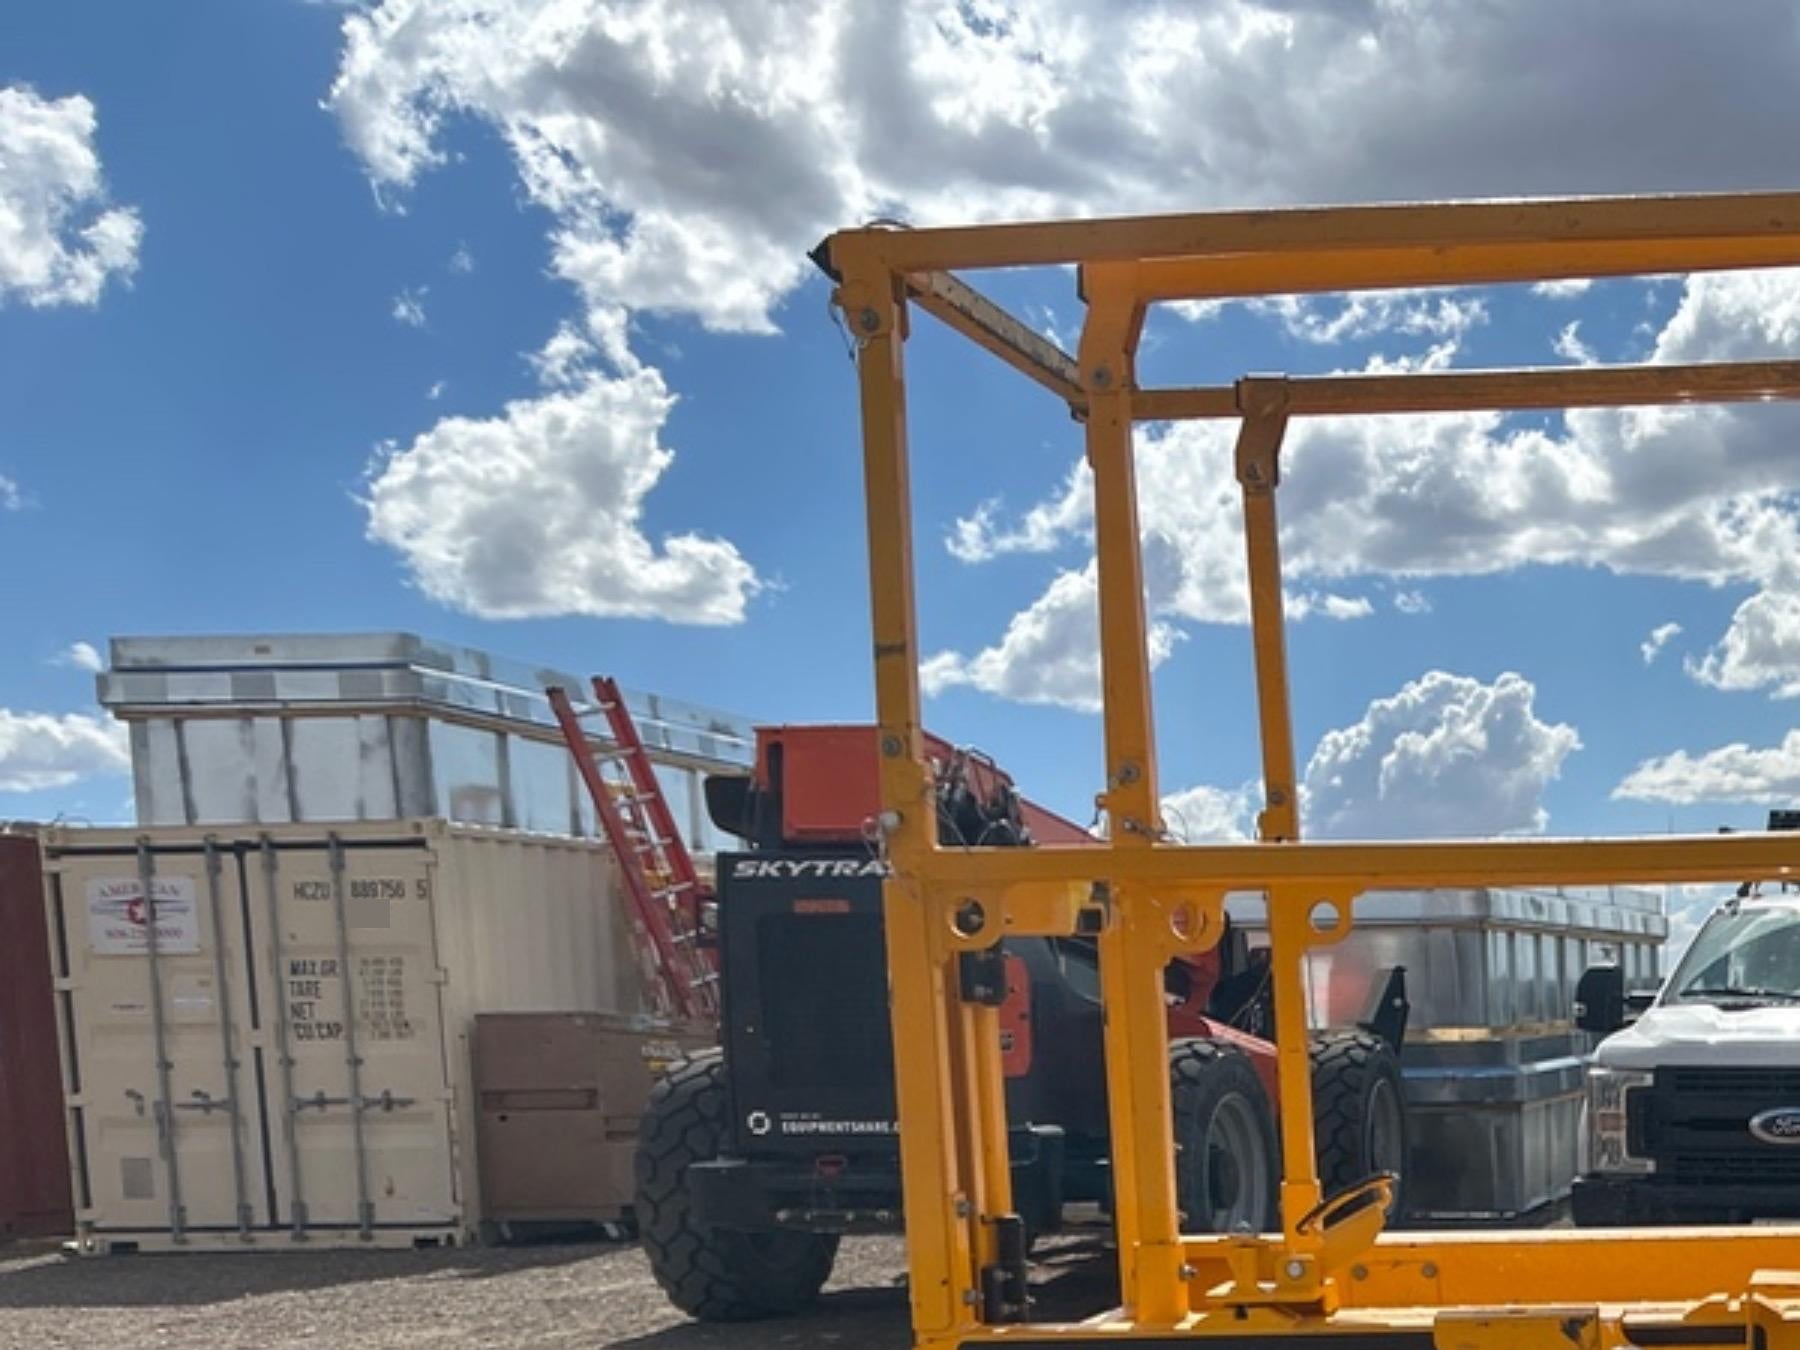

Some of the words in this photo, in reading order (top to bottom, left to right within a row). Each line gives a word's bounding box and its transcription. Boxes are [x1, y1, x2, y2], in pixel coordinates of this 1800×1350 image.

[732, 859, 894, 879] SKYTRA
[289, 981, 321, 998] TARE
[290, 1002, 315, 1019] NET
